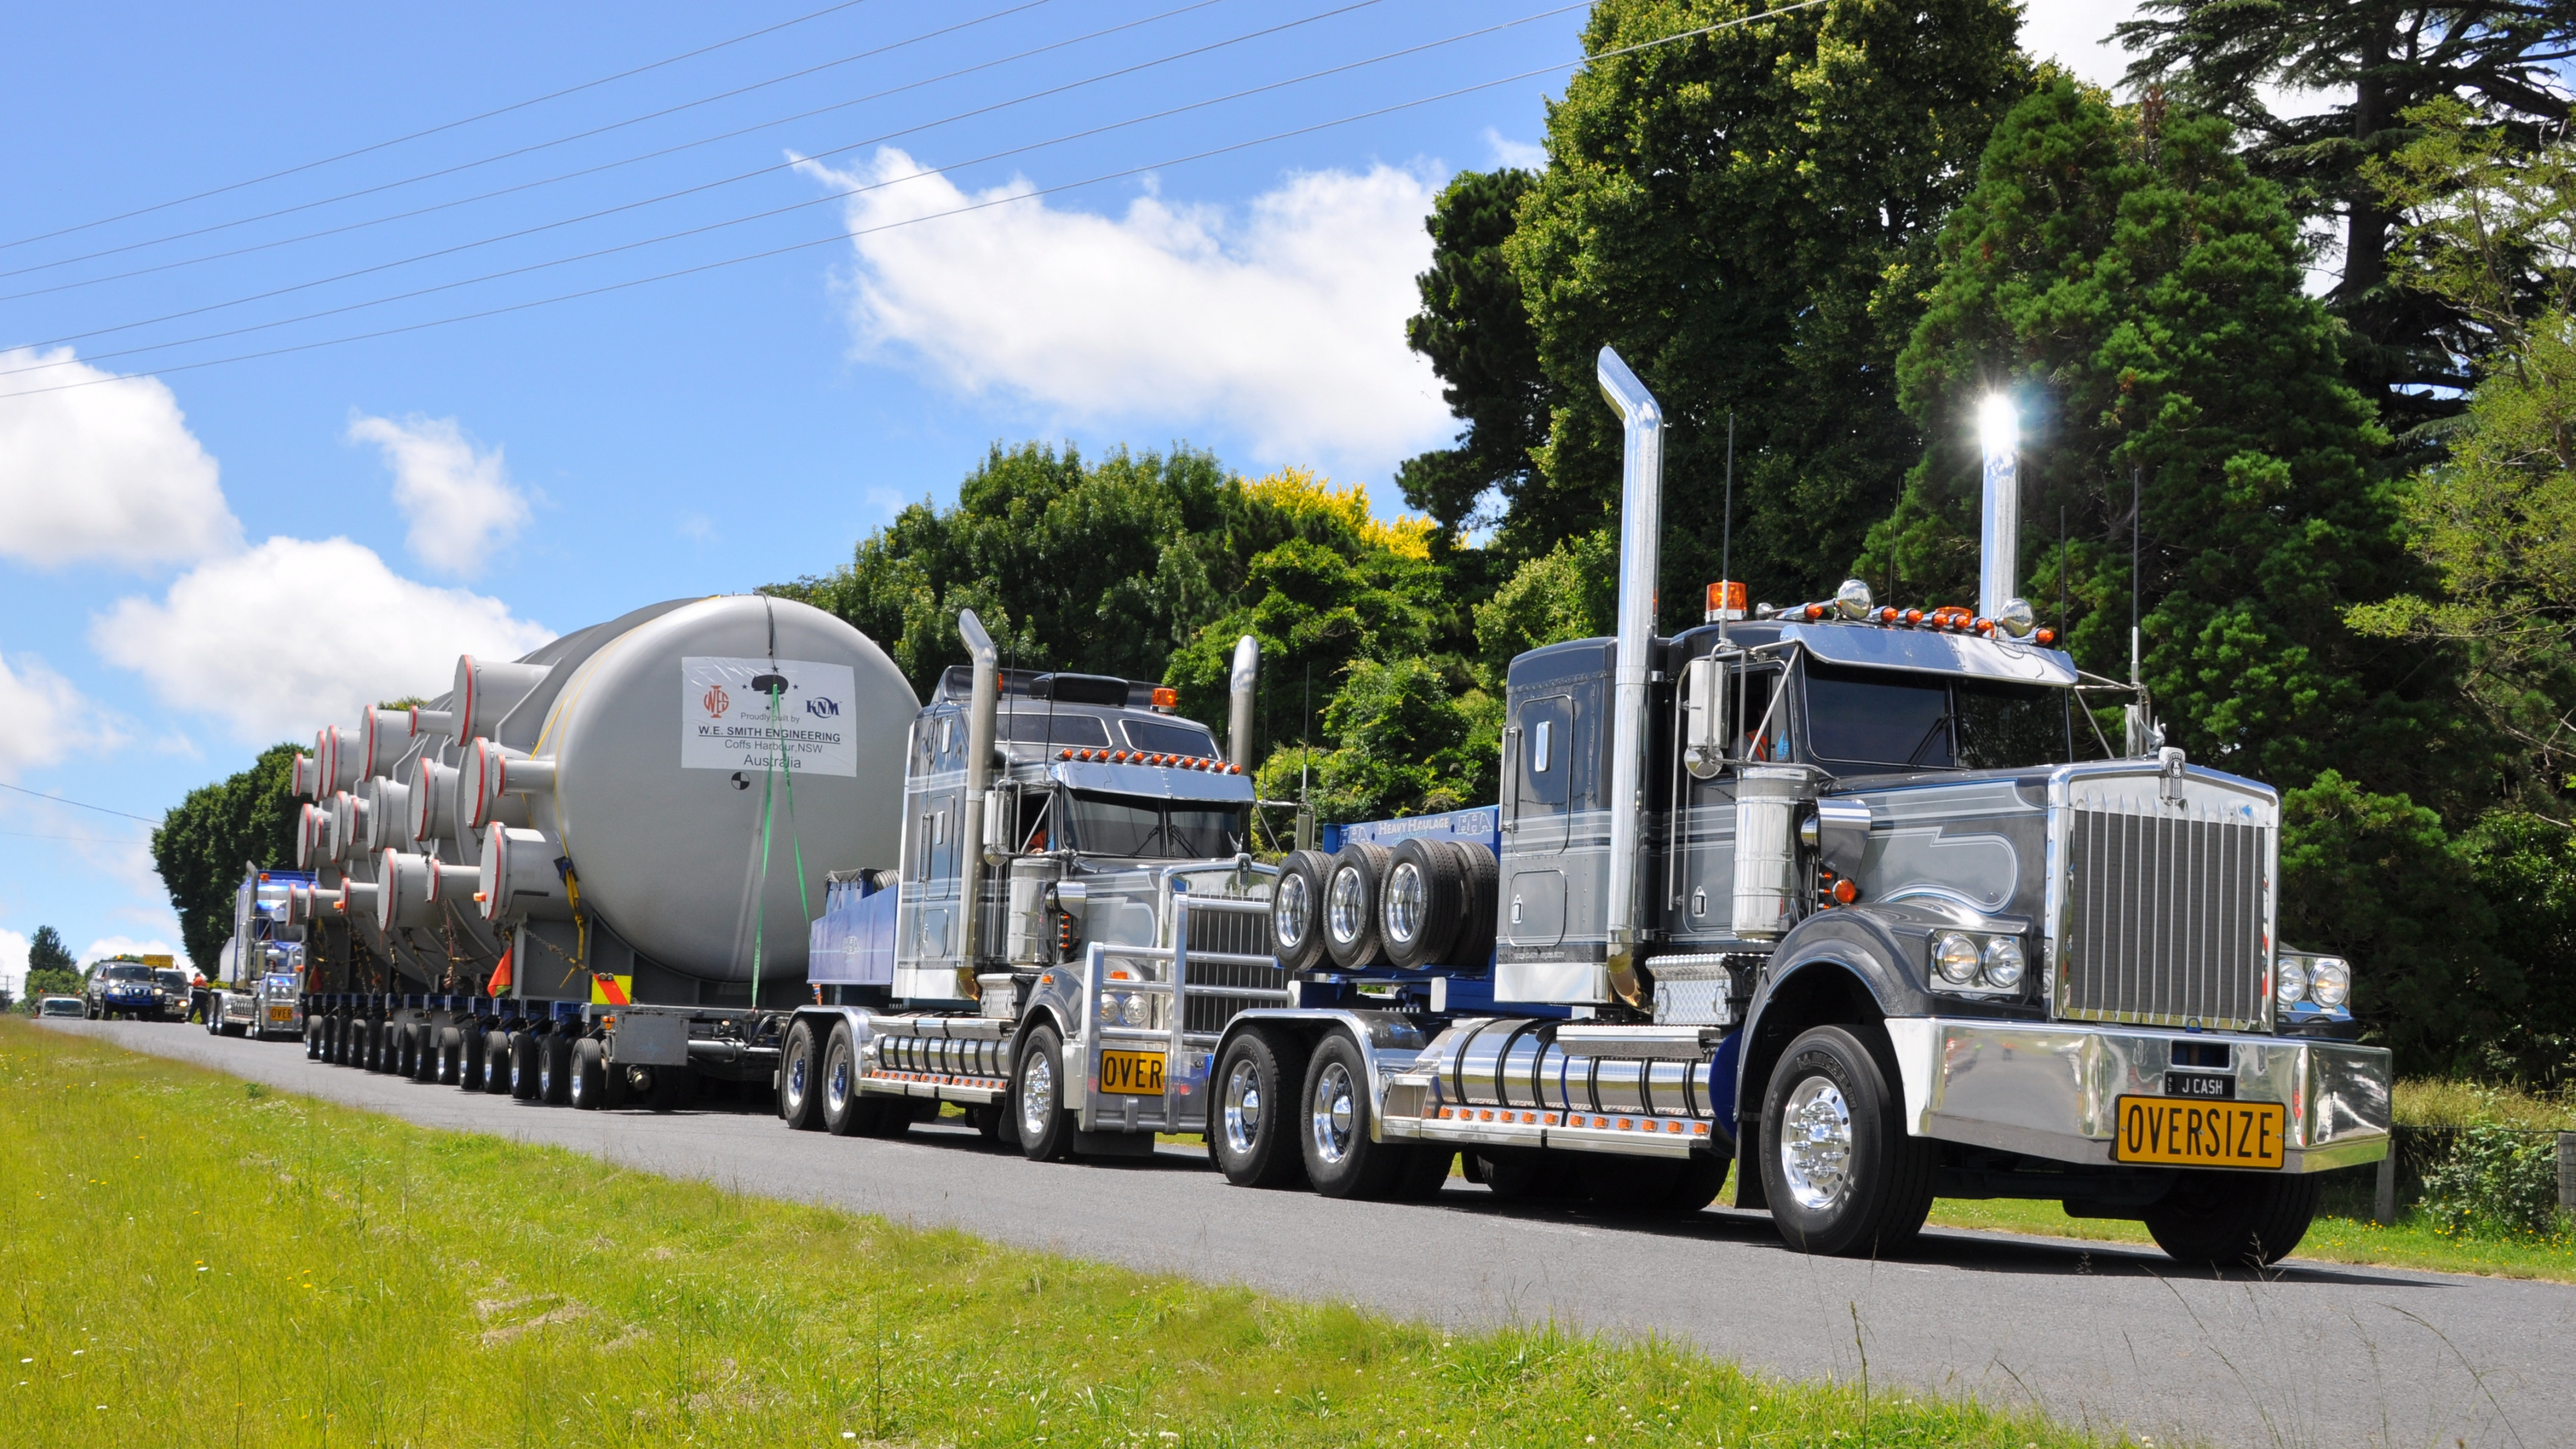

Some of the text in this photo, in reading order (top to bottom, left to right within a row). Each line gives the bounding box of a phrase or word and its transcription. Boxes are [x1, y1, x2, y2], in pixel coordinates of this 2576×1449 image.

[806, 697, 841, 718] KNM
[741, 712, 770, 722] Proudly
[790, 715, 800, 724] by
[698, 726, 841, 742] W.E. SMITH ENGINEERING
[724, 739, 751, 749] Coffs
[743, 754, 801, 769] Australia
[1378, 816, 1450, 836] HEAVY HAULAGE
[271, 1008, 292, 1019] OVER
[1104, 1056, 1163, 1089] OVER
[1811, 1051, 1858, 1110] MICHELIN
[2182, 1078, 2223, 1095] J CASH
[2127, 1104, 2273, 1159] OVERSIZE
